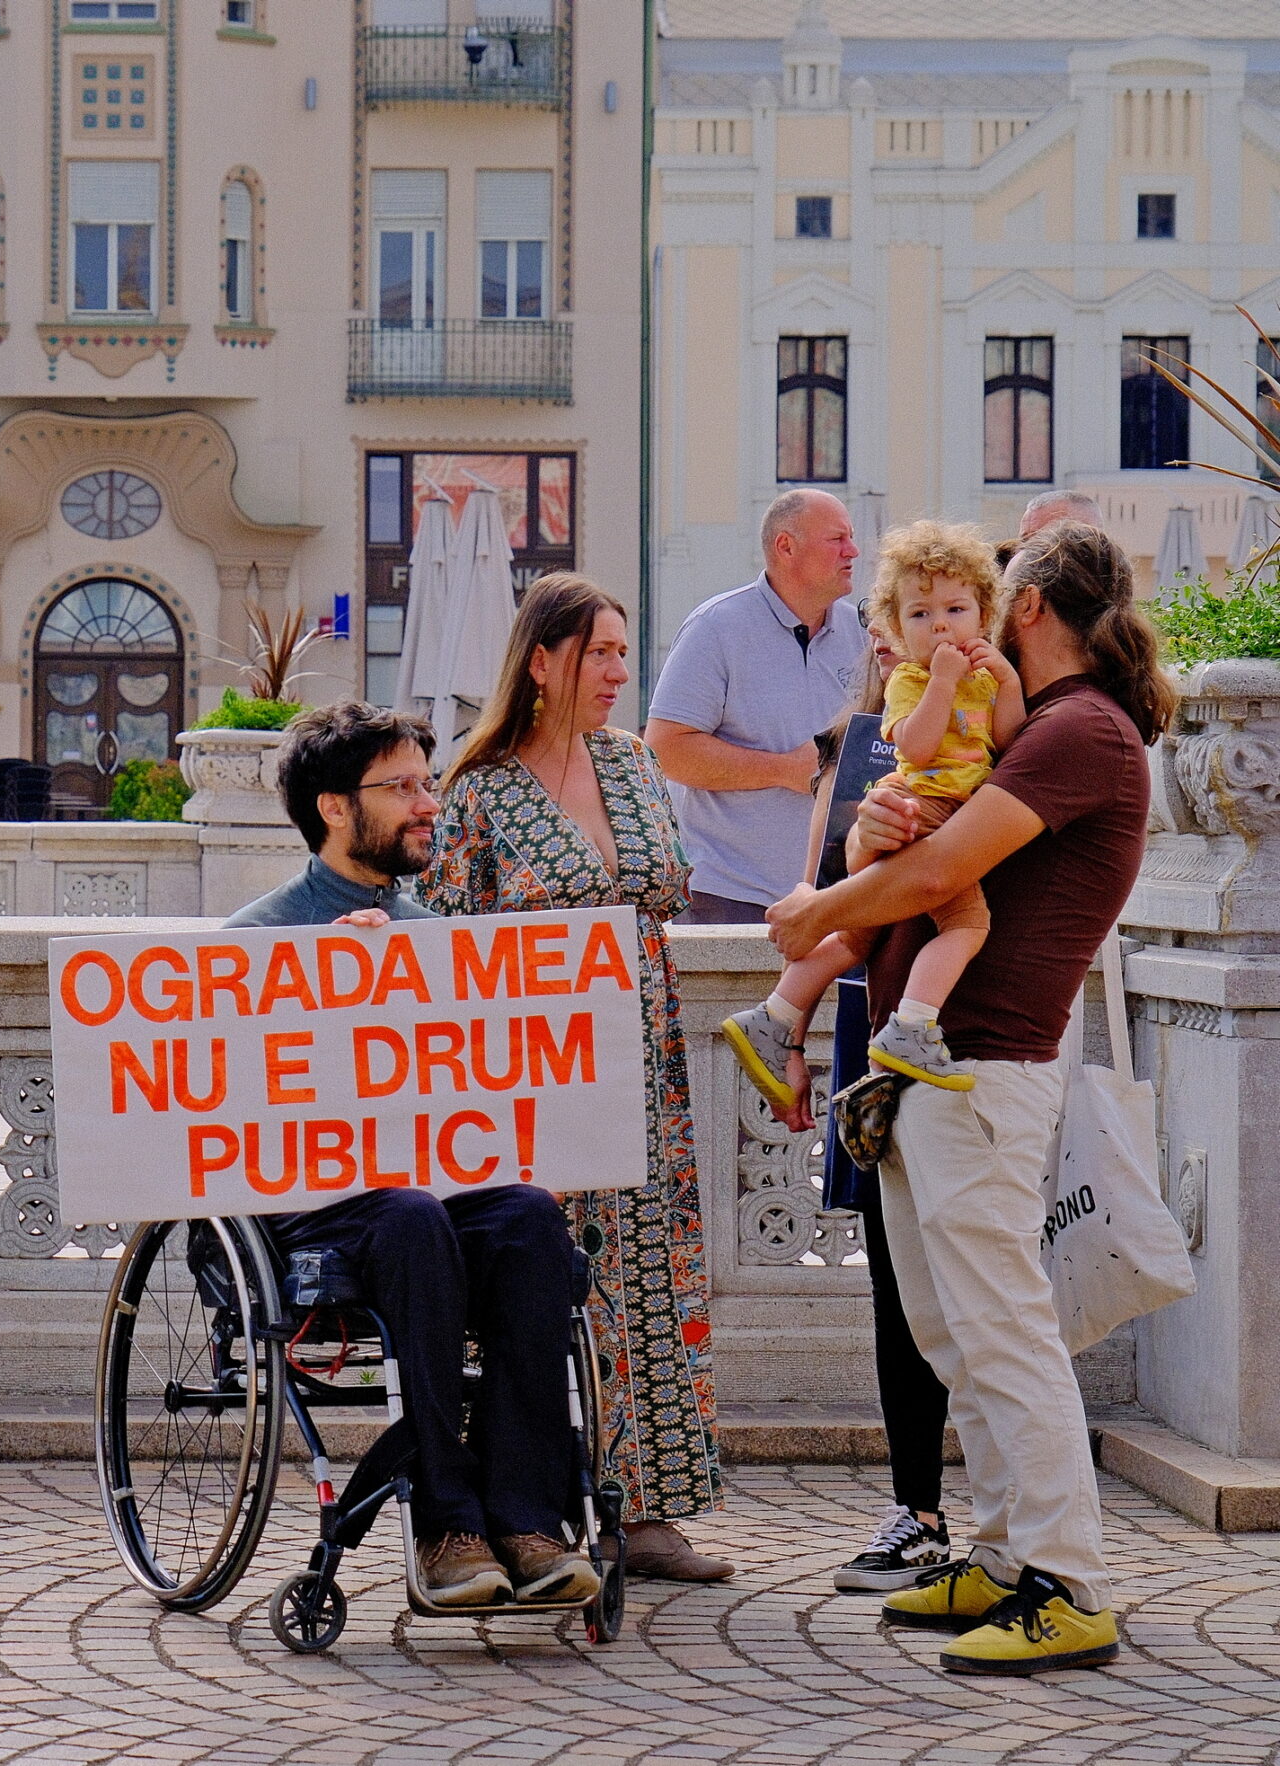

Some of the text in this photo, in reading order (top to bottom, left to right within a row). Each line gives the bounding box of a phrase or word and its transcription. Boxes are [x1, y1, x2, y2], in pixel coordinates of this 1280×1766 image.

[60, 921, 634, 1027] OGRADA MEA
[109, 1011, 596, 1114] NU E DRUM
[187, 1097, 537, 1198] PUBLIC!
